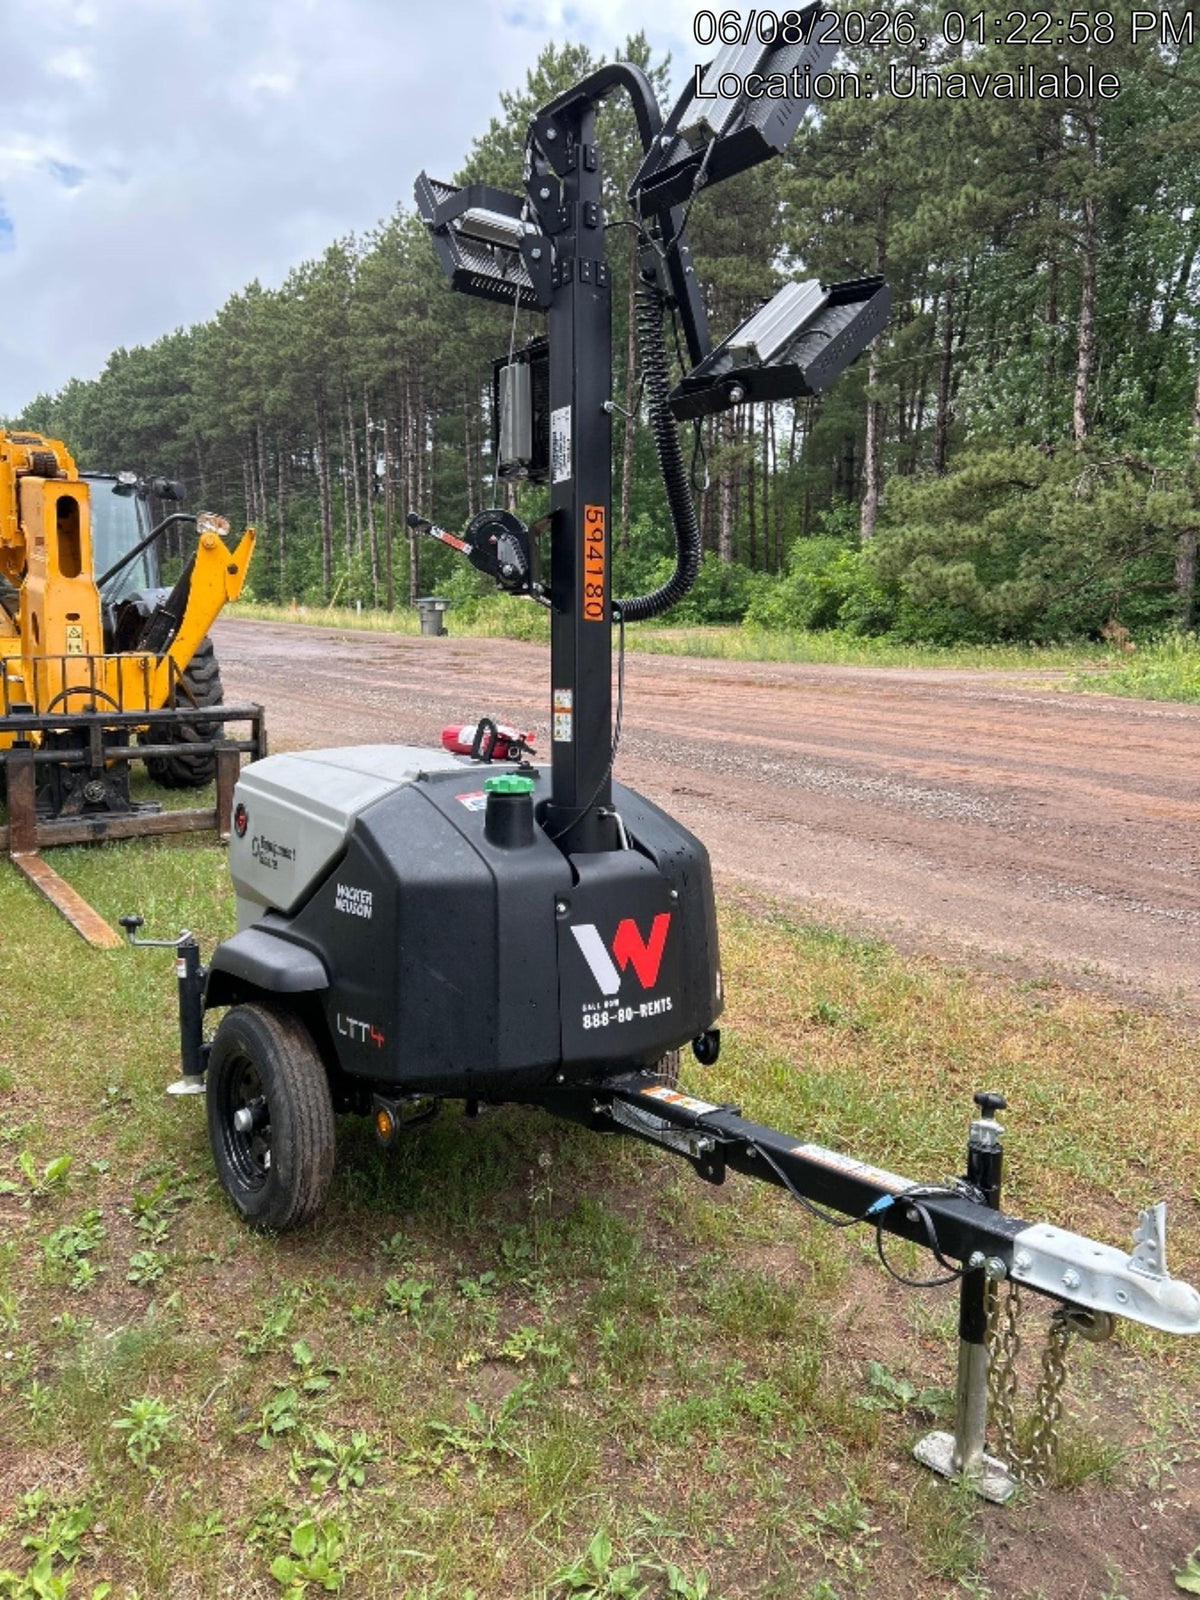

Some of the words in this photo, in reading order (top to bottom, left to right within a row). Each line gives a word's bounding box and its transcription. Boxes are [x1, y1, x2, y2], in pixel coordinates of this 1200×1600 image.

[586, 508, 604, 617] 594180
[337, 883, 373, 905] WACKER
[582, 997, 673, 1029] 888-80-RENTS
